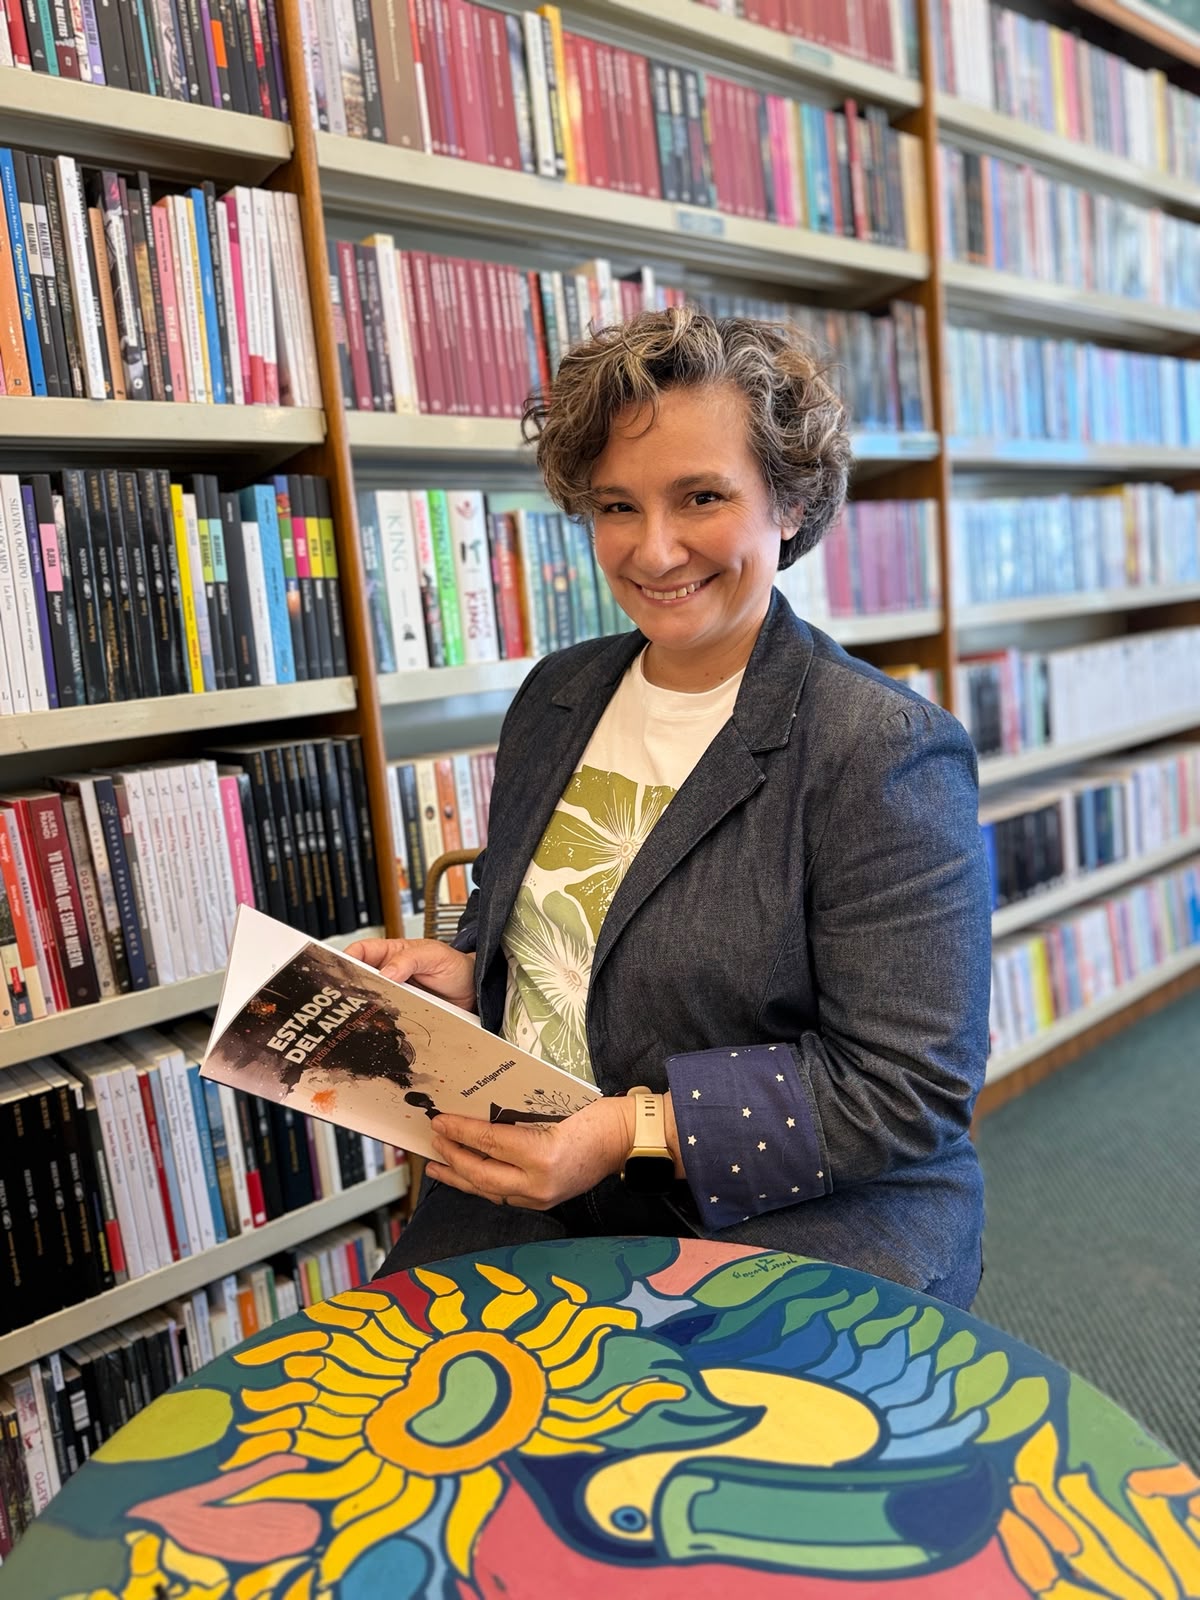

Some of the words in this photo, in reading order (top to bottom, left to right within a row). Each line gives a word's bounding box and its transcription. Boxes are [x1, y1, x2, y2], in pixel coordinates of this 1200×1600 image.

[55, 6, 68, 38] BILLETES
[25, 222, 37, 255] MALIANDI
[38, 221, 50, 259] MALIANDI
[13, 242, 28, 290] Operación
[21, 290, 34, 320] Índigo
[8, 497, 21, 535] SILVINA
[13, 537, 27, 579] OCAMPO
[46, 547, 56, 567] OJEDA
[386, 514, 408, 572] KING
[38, 810, 51, 839] PRANDI
[46, 809, 59, 838] JULIETA
[47, 850, 63, 863] YO
[140, 843, 148, 856] Puig
[183, 836, 191, 849] Puig
[49, 861, 72, 896] TENDRÍA
[79, 869, 90, 890] DOS
[107, 818, 122, 863] LORENA
[127, 924, 139, 956] LOCA
[55, 894, 73, 912] QUE
[59, 911, 78, 937] ESTAR
[84, 894, 101, 948] SOLDADOS
[64, 935, 84, 968] MUERTA
[266, 986, 342, 1052] ESTADOS
[285, 1034, 325, 1064] DEL
[317, 996, 368, 1034] ALMA
[306, 1047, 331, 1068] Frutos
[328, 1039, 337, 1048] de
[336, 1029, 350, 1041] mis
[347, 1004, 380, 1031] Oraciones
[460, 1085, 479, 1098] Nora
[476, 1059, 516, 1087] Estigarribia
